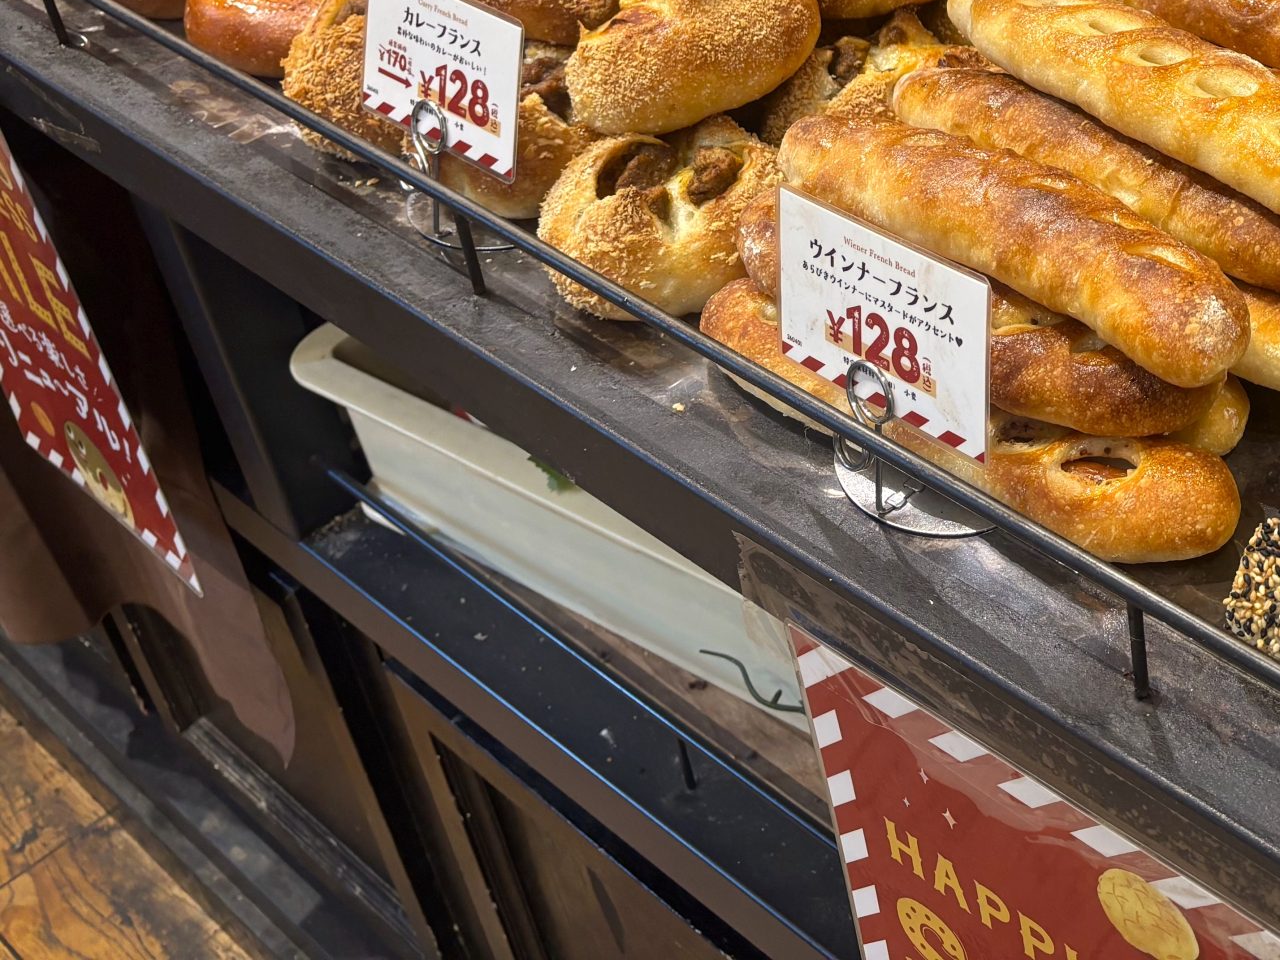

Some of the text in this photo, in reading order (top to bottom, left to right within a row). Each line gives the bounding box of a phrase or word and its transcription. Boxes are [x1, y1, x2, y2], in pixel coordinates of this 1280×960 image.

[403, 6, 482, 57] カレーフランス
[434, 3, 452, 19] French
[452, 12, 469, 26] Bread
[379, 48, 407, 71] ¥170
[420, 64, 490, 128] ¥128
[809, 238, 955, 325] ウインナーフランス
[843, 236, 916, 279] Wiener French Bread
[826, 305, 921, 384] ¥128
[884, 816, 1079, 960] HAPP
